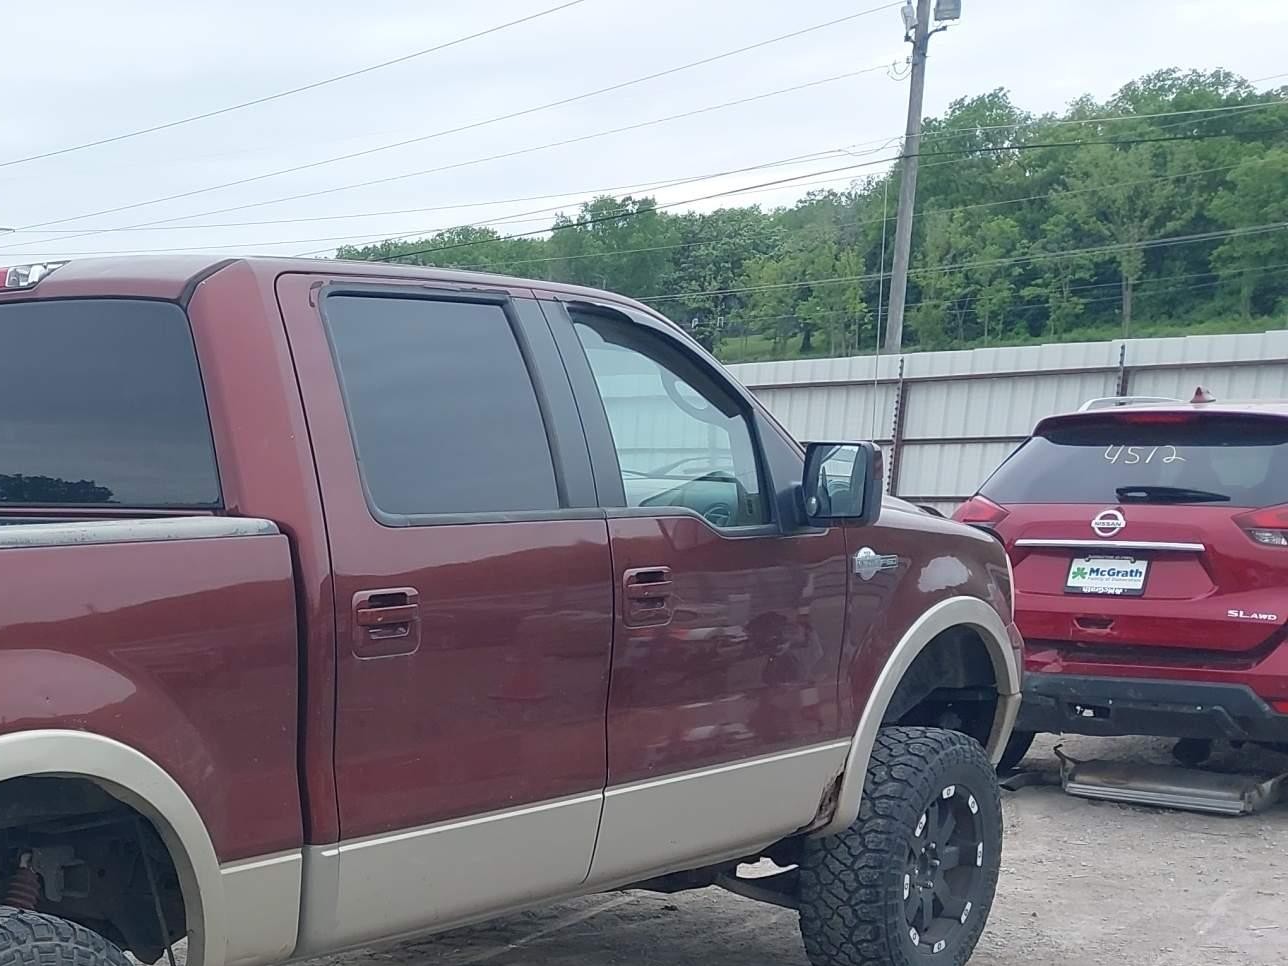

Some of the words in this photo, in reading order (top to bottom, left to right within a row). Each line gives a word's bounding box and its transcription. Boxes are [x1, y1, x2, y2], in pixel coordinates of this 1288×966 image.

[1104, 444, 1186, 464] 4512
[1094, 520, 1122, 528] NISSAN
[1088, 567, 1143, 578] McGrath
